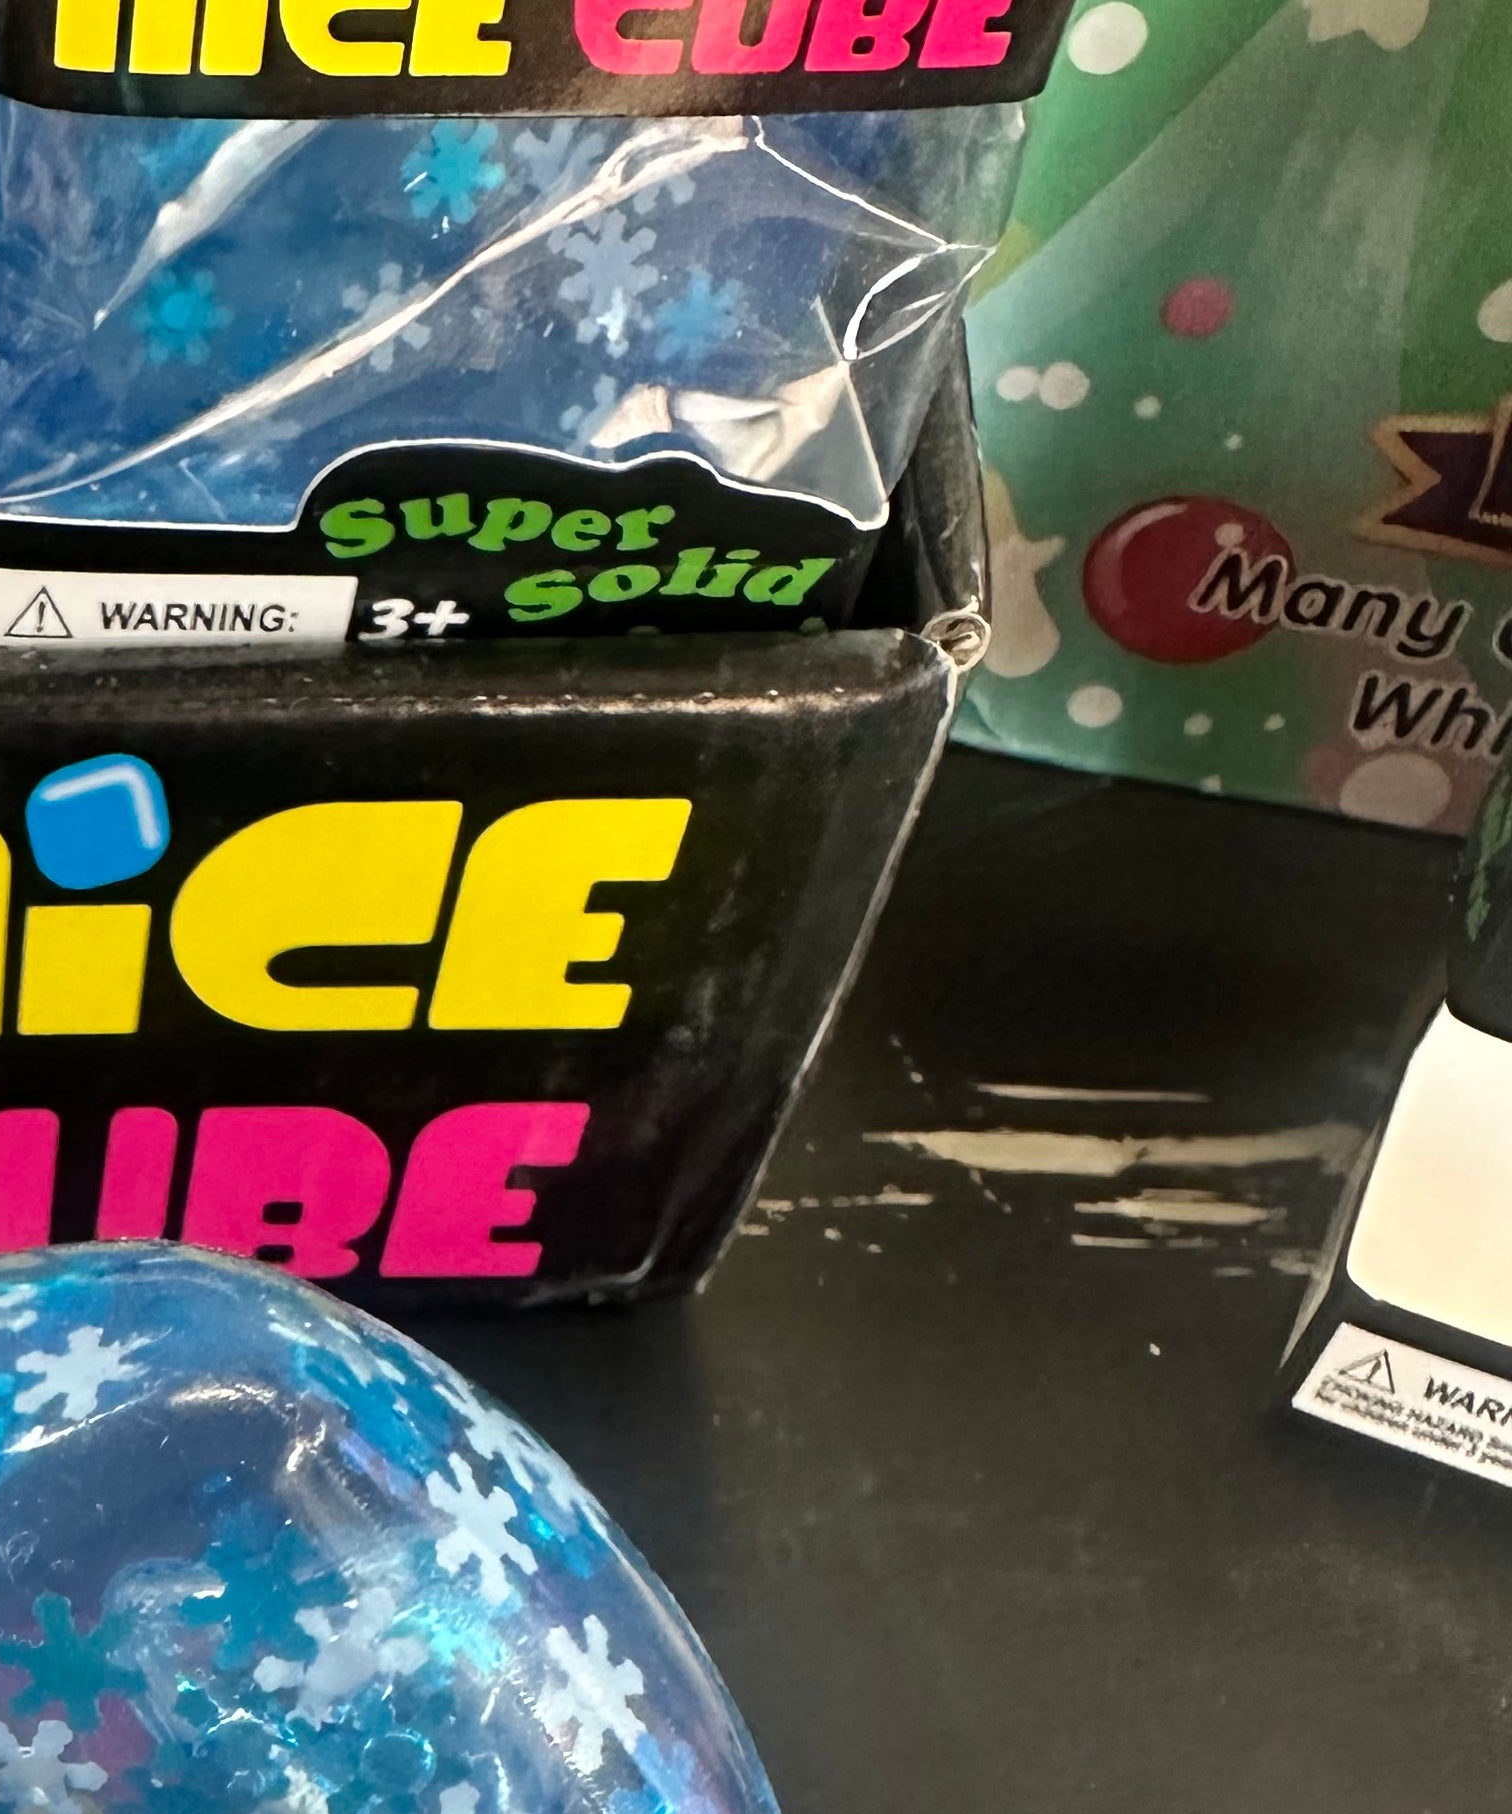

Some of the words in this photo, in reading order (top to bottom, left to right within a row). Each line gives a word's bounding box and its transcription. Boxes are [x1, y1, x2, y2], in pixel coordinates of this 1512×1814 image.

[319, 492, 676, 559] Super
[100, 601, 300, 634] WARNING:
[503, 546, 836, 623] Solid
[1192, 550, 1469, 661] Many
[358, 598, 471, 641] 3+
